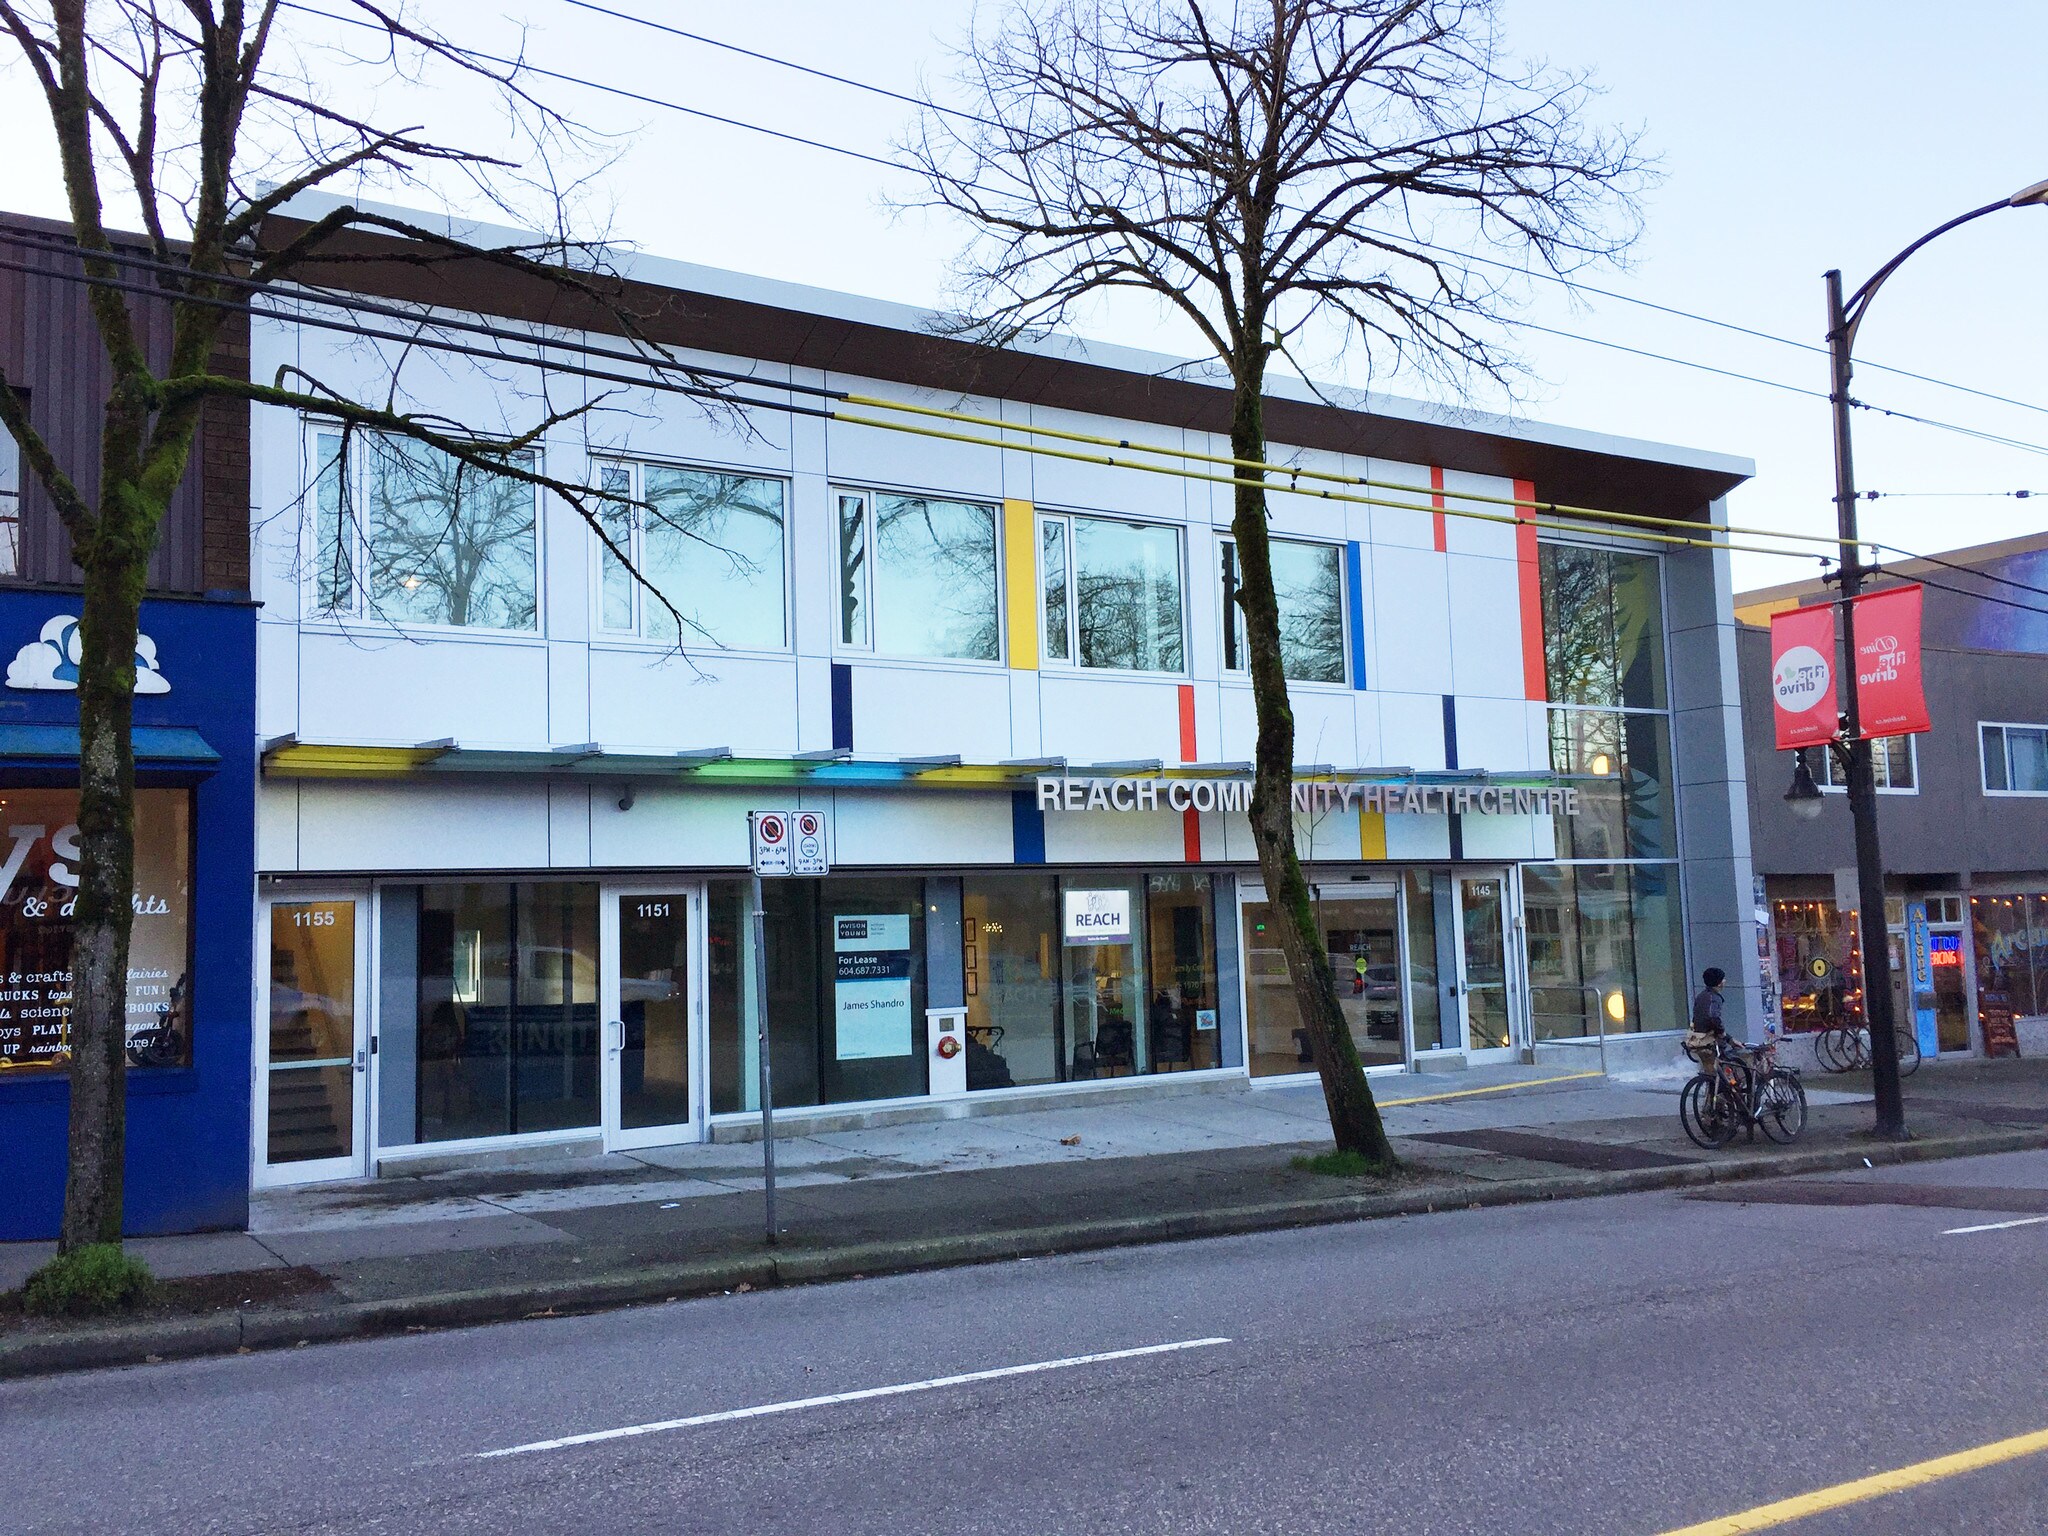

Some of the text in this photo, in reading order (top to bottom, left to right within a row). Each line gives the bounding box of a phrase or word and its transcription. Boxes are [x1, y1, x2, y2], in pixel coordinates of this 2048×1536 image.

[1037, 778, 1158, 812] REACH
[1362, 783, 1470, 815] HEALTH
[1479, 786, 1580, 817] CENTRE
[1471, 886, 1491, 896] 1145
[637, 903, 670, 917] 1151
[293, 911, 335, 927] 1155
[1075, 913, 1120, 927] REACH
[838, 955, 877, 965] For Lease
[26, 970, 73, 983] crafts
[838, 966, 890, 976] 604.687.7331
[843, 999, 905, 1011] James Shandro
[4, 1043, 21, 1055] UP
